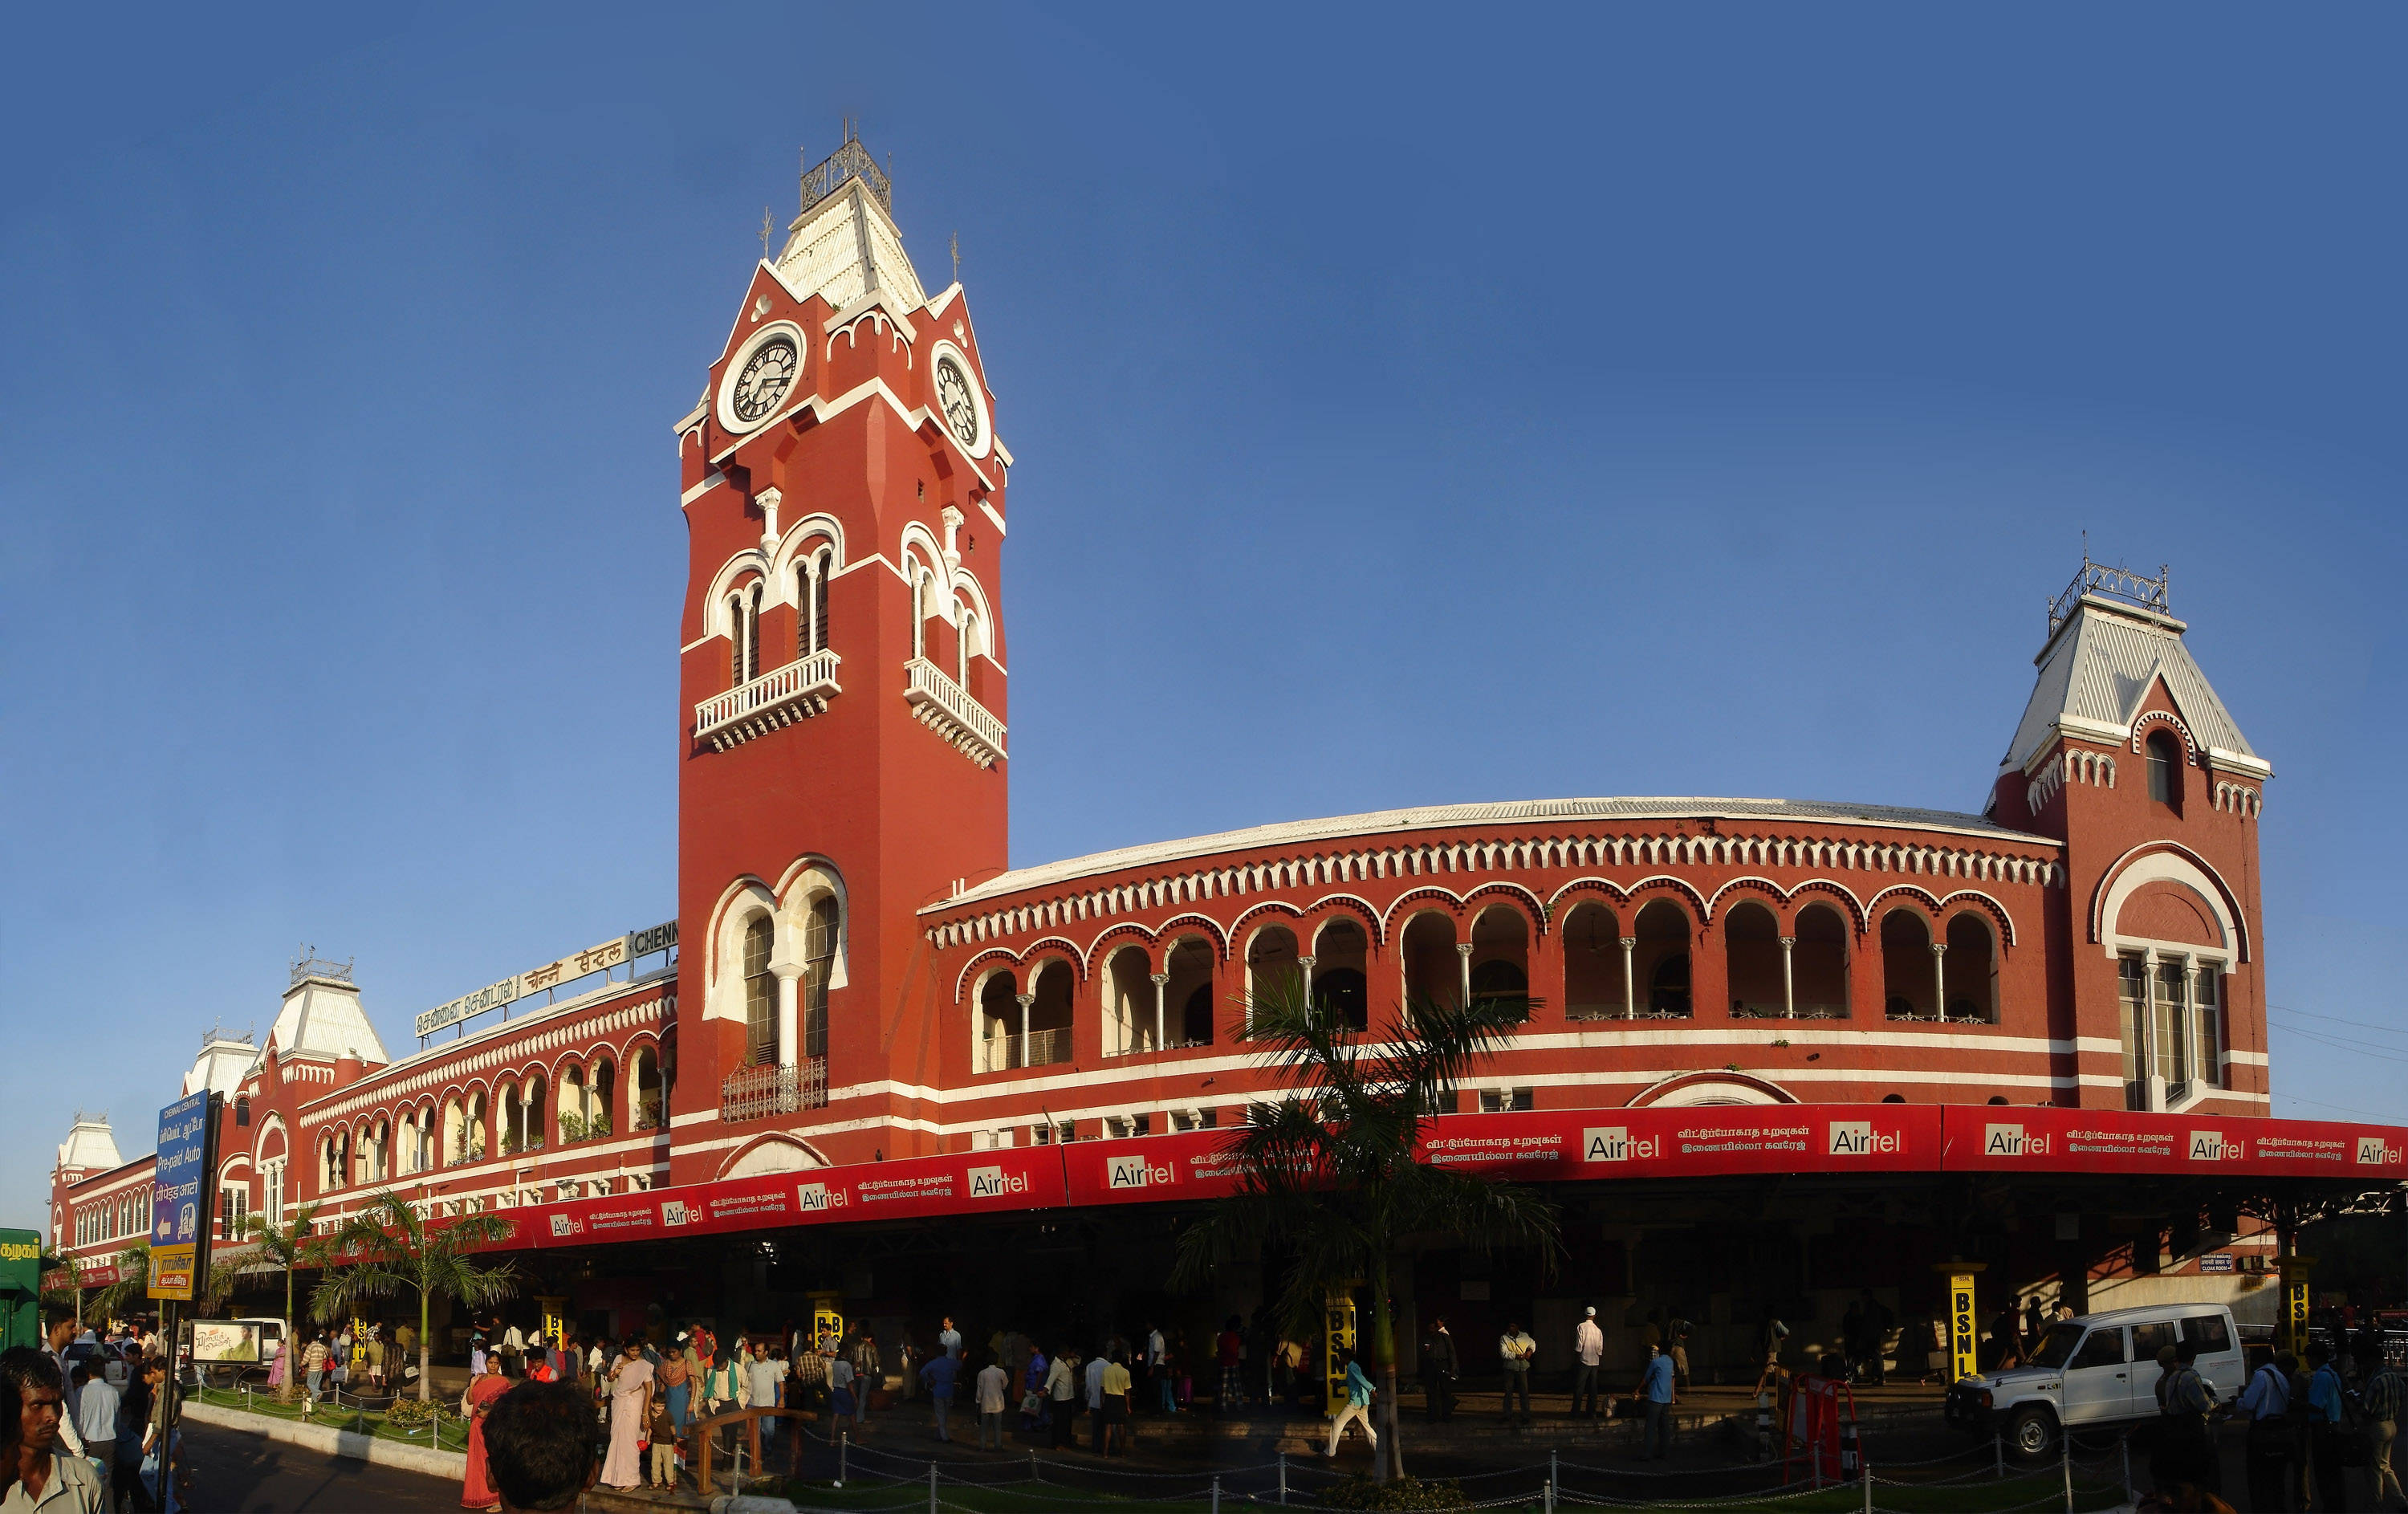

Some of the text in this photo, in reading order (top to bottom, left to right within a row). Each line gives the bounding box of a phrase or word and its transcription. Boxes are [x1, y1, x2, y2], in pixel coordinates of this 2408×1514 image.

[164, 1097, 201, 1119] CHENNAI CENTRAL
[1513, 1134, 1562, 1147] உறவுகள்
[1763, 1125, 1809, 1138] உறவுகள்
[1833, 1129, 1900, 1152] Airtel
[1988, 1131, 2050, 1154] Airtel
[2136, 1133, 2174, 1143] உறவுகள்
[1588, 1134, 1659, 1159] Airtel
[2192, 1138, 2244, 1159] Airtel
[2314, 1140, 2345, 1150] உறவுகள்
[2360, 1144, 2402, 1163] Airtel
[157, 1145, 201, 1172] Pre-paid Auto
[917, 1174, 953, 1186] உறவுகள்
[973, 1171, 1028, 1195] Airtel
[1112, 1161, 1174, 1186] Airtel
[803, 1186, 848, 1210] Airtel
[554, 1215, 584, 1235] Airtel
[665, 1205, 703, 1225] Airtel
[0, 1238, 40, 1261] கழகம்
[2293, 1284, 2306, 1356] BSNL
[1956, 1293, 1971, 1378] BSNL
[1330, 1310, 1346, 1398] BSNL
